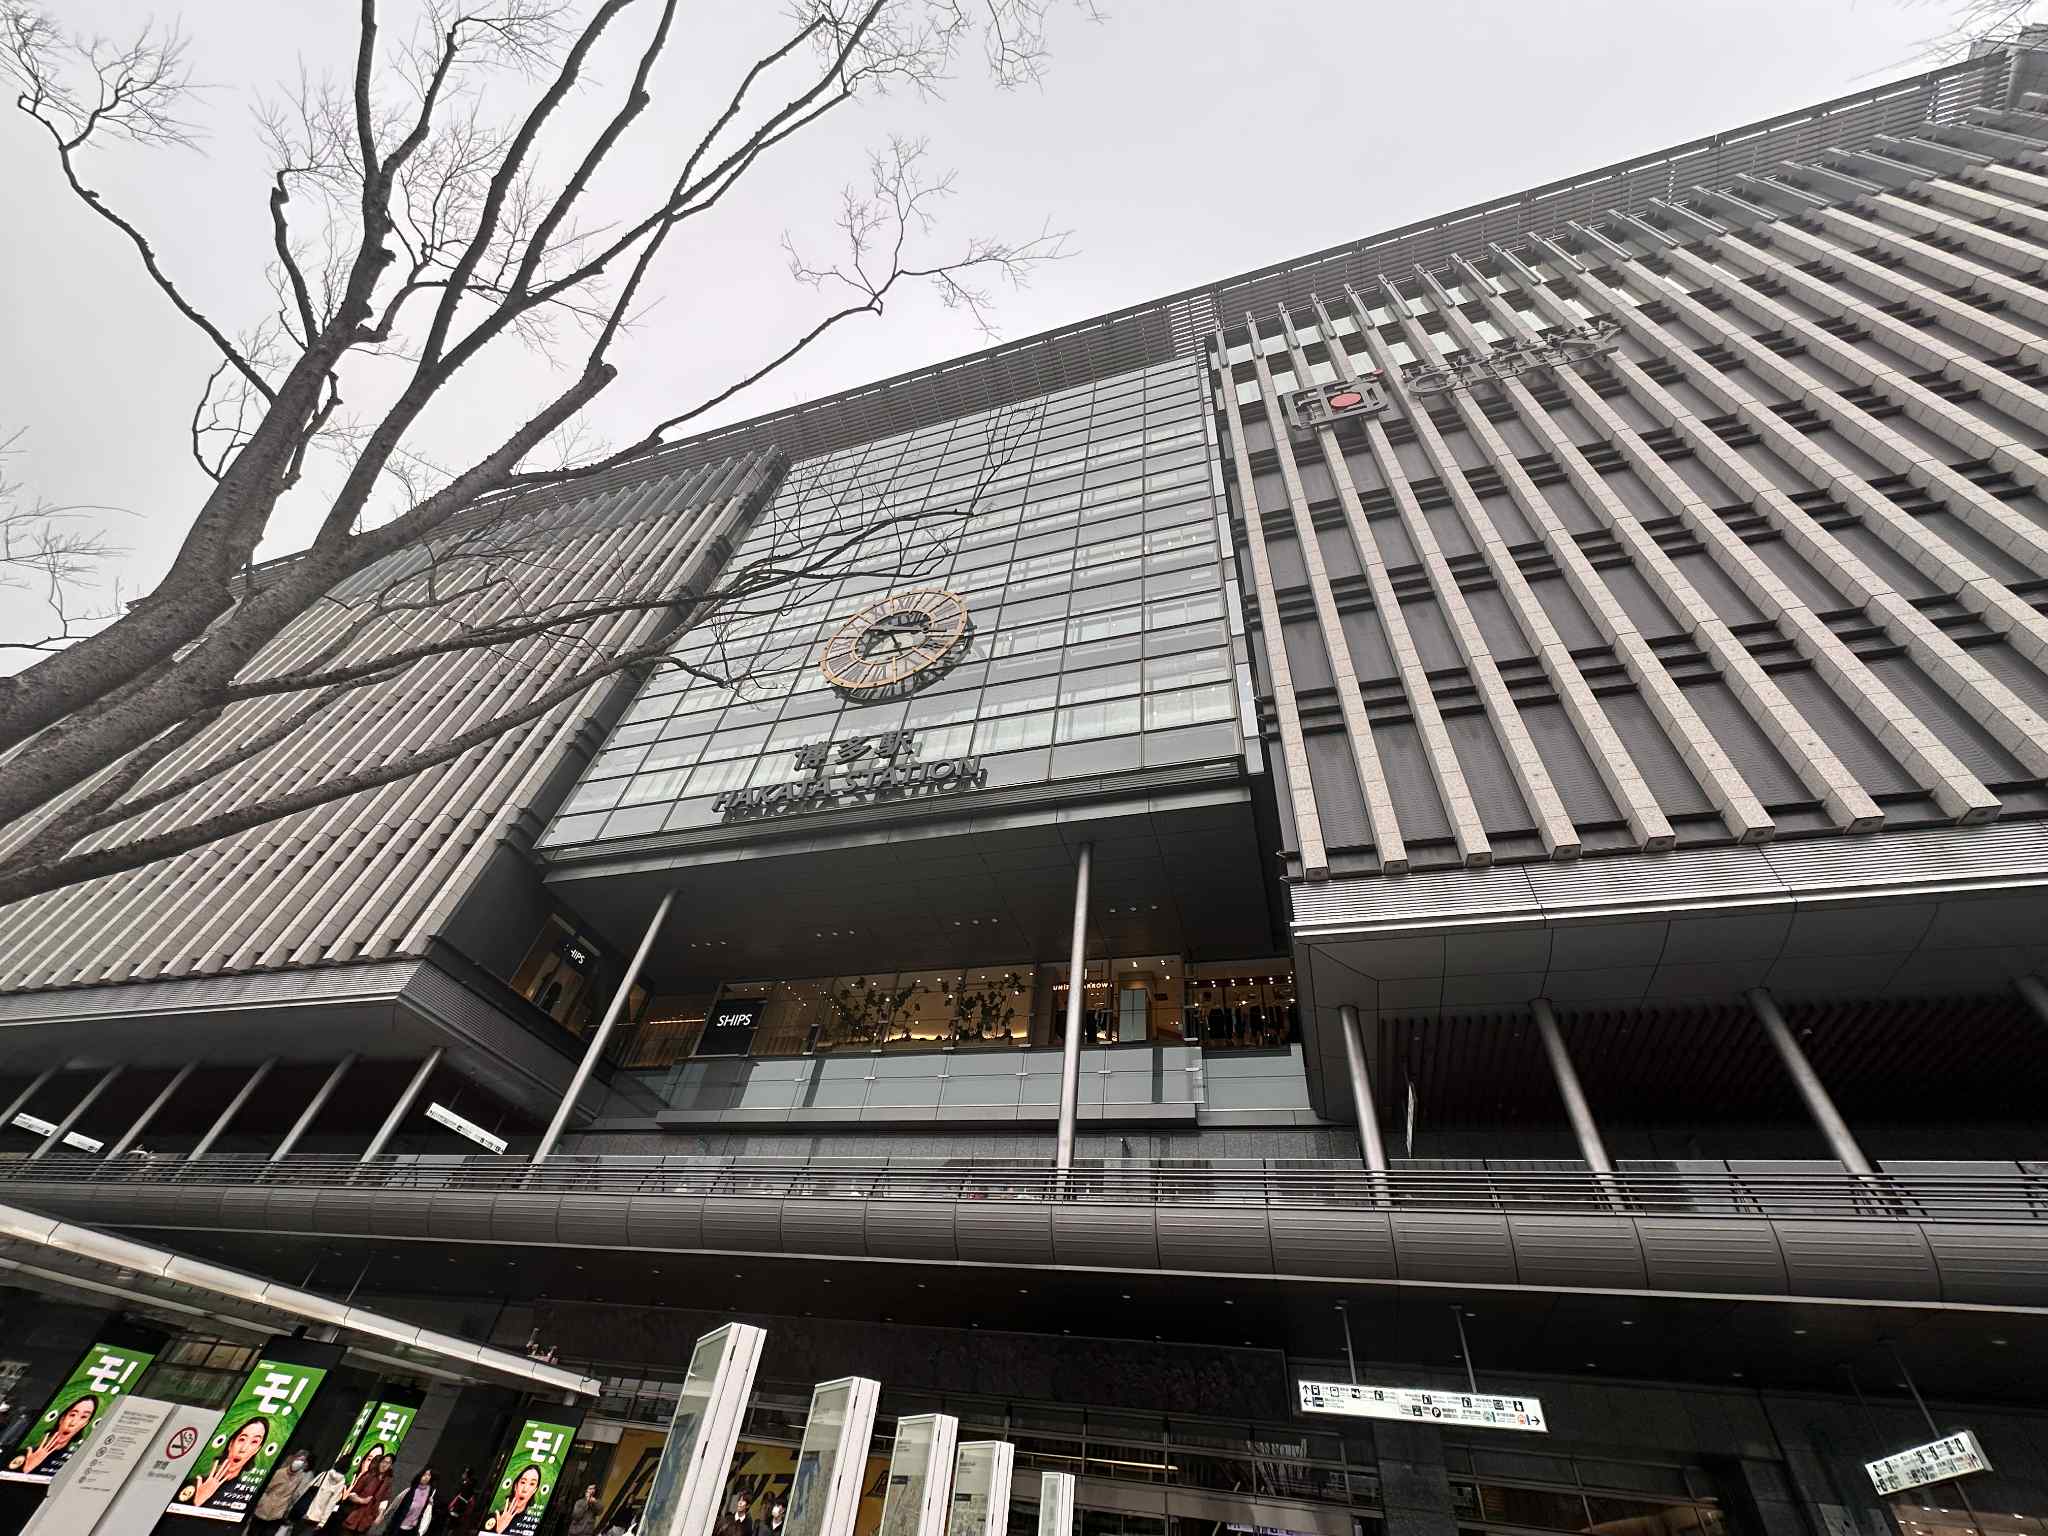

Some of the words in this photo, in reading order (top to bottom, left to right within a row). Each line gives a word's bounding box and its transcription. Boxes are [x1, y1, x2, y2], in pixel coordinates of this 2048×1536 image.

[794, 729, 916, 771] 博多駅
[711, 775, 832, 813] HAKATA
[844, 755, 982, 797] STATION
[716, 1014, 753, 1027] SHIPS
